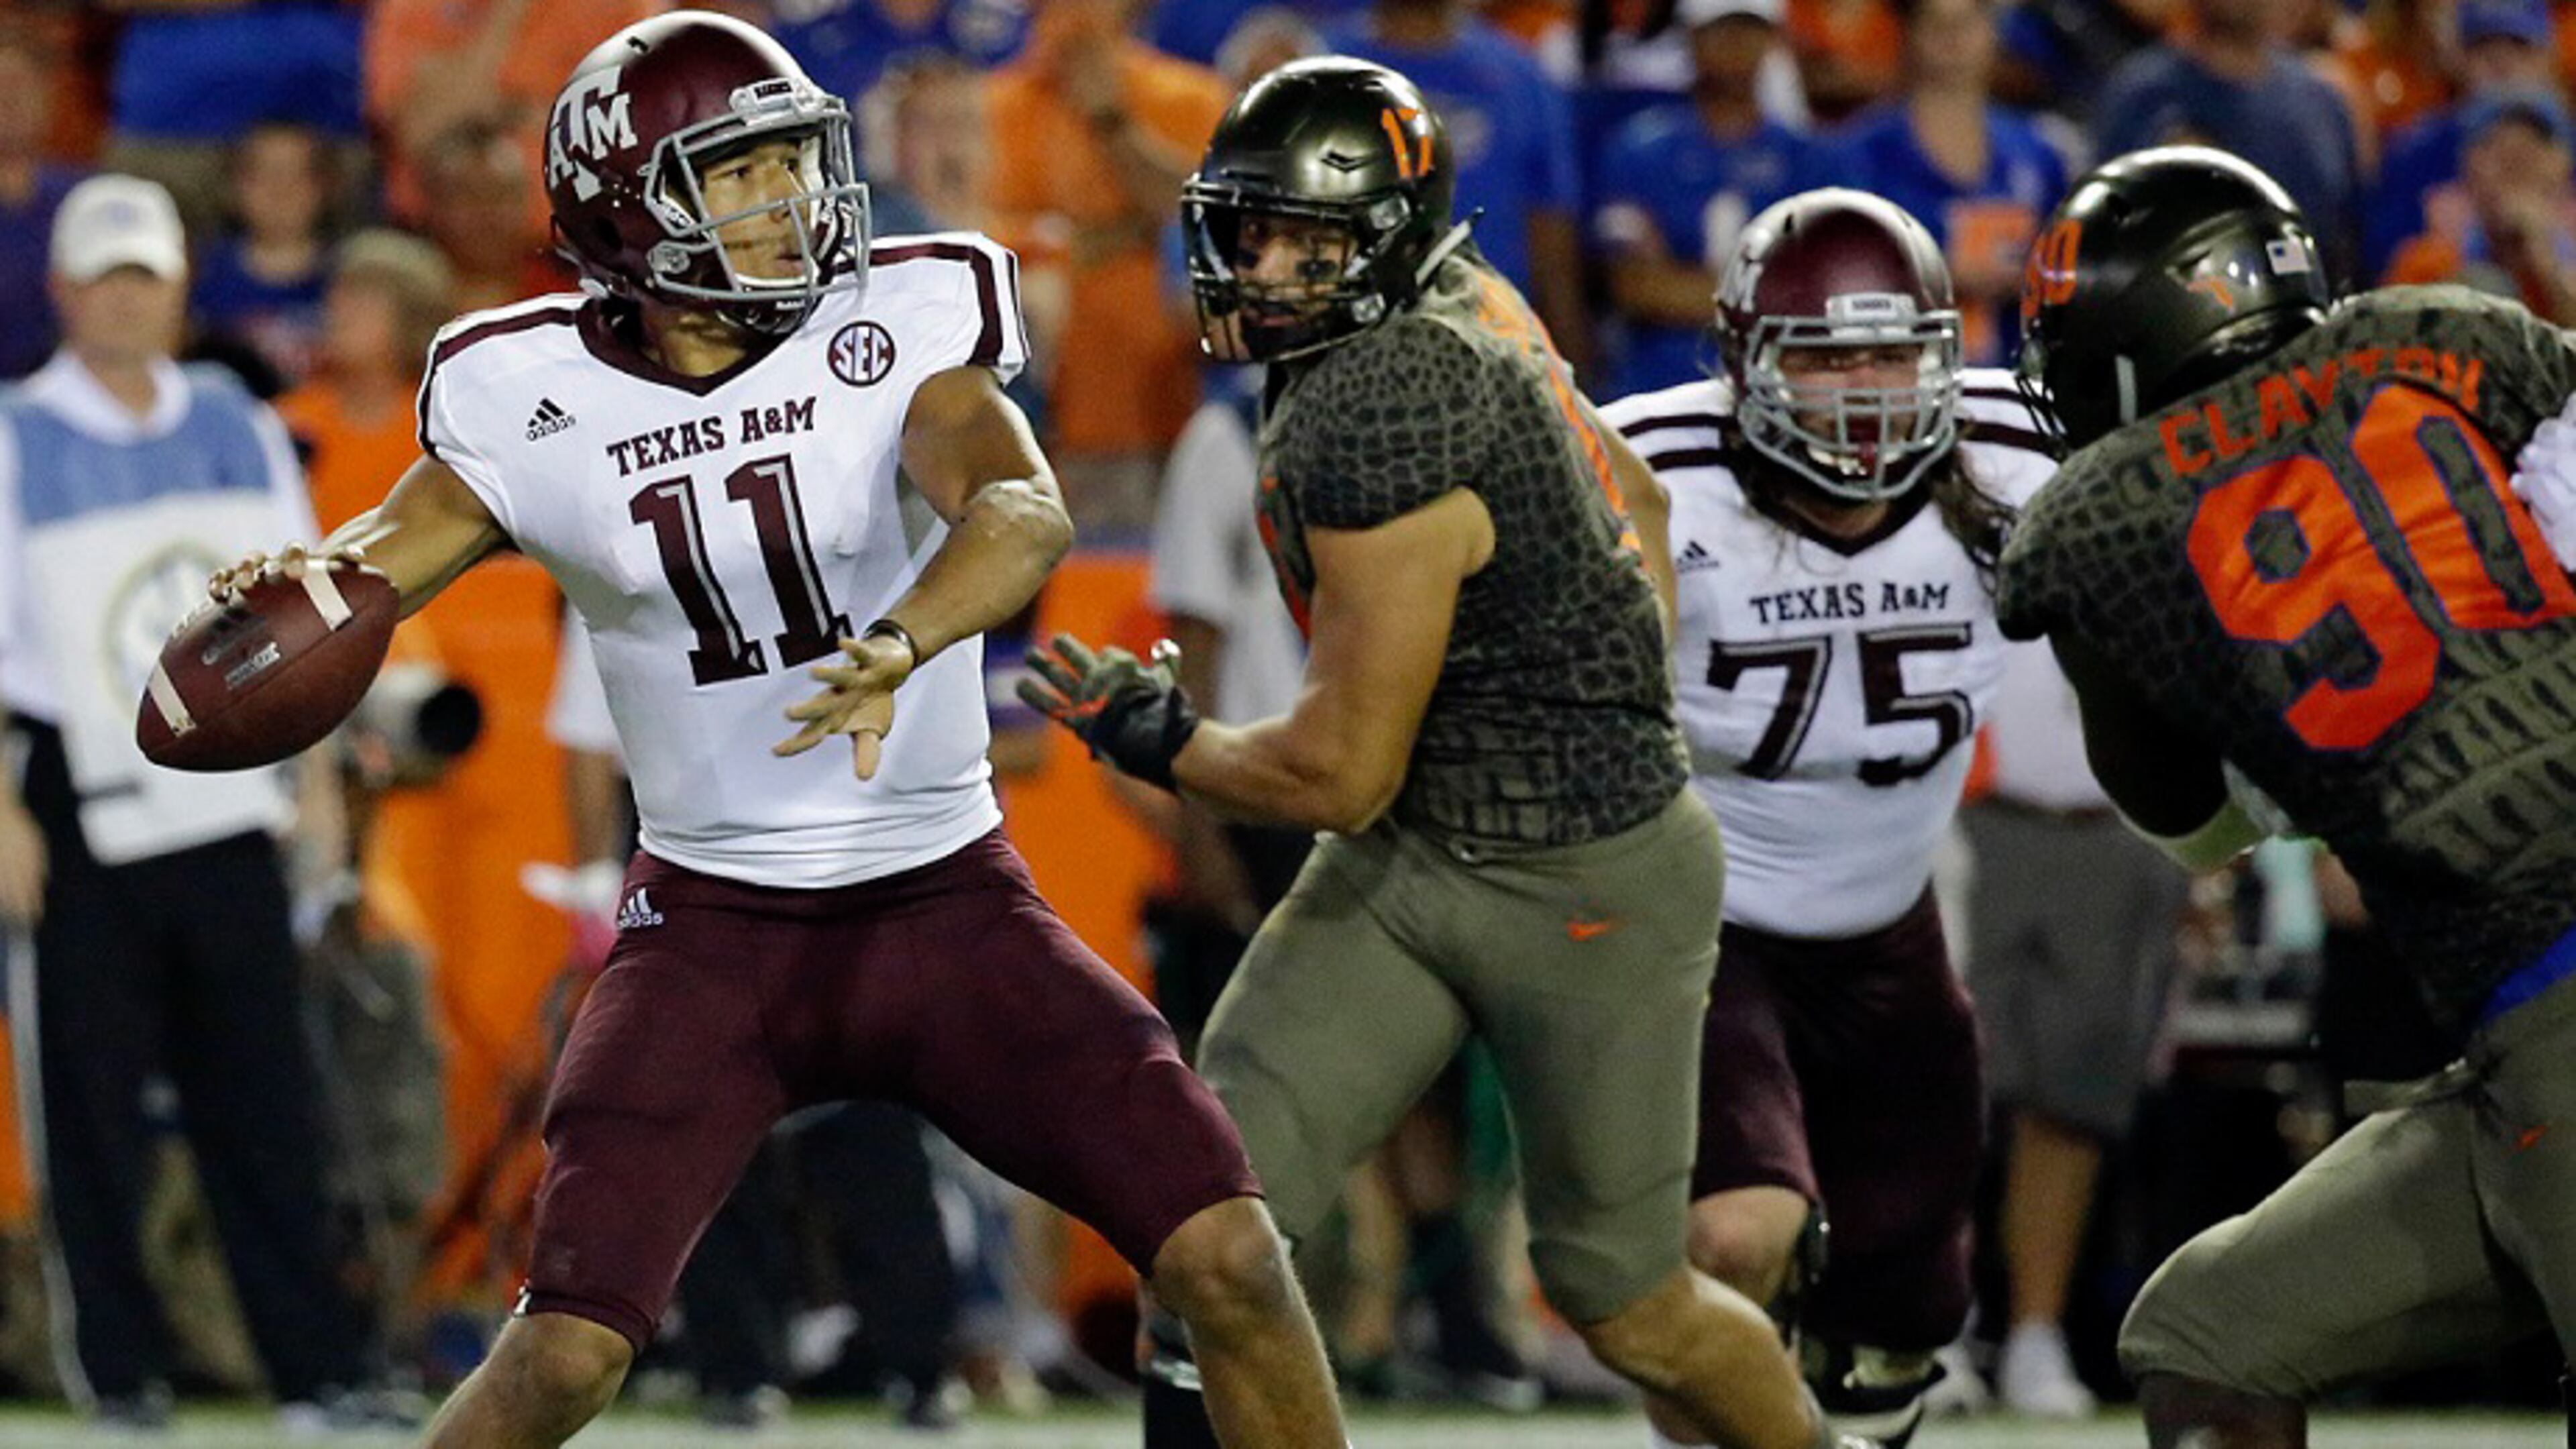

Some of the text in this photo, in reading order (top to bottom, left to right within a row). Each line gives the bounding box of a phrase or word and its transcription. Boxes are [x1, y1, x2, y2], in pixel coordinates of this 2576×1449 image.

[1381, 107, 1434, 178] 17
[835, 326, 890, 381] SEC
[526, 415, 576, 441] adidas
[606, 396, 817, 477] TEXAS A&M
[629, 453, 854, 686] 11
[1749, 582, 1950, 625] TEXAS A&M
[2186, 381, 2576, 751] 90
[1706, 621, 1974, 787] 75
